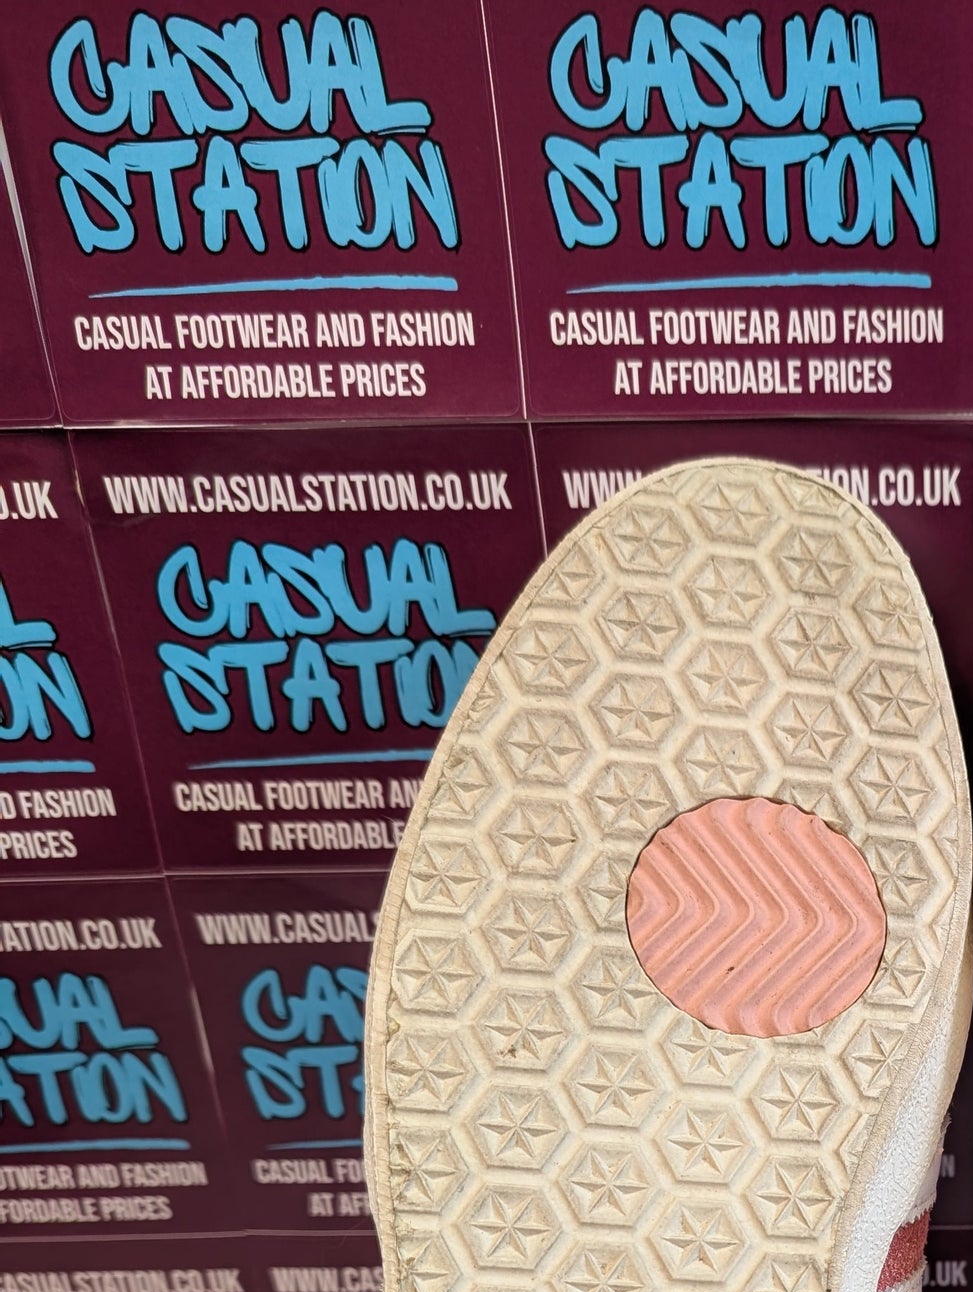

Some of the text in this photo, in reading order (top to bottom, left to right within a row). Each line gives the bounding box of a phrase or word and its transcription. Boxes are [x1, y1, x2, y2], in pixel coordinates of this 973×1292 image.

[50, 10, 432, 137] CASUAL
[549, 6, 924, 132] CASUAL
[53, 135, 460, 254] STATION
[542, 129, 939, 250] STATION
[75, 311, 475, 351] CASUAL FOOTWEAR AND FASHION
[550, 308, 943, 346] CASUAL FOOTWEAR AND FASHION
[146, 362, 426, 400] AT AFFORDABLE PRICES
[615, 359, 892, 395] AT AFFORDABLE PRICES
[104, 471, 512, 514] WWW.CASUALSTATION.CO.UK
[156, 539, 498, 639] CASUAL
[15, 788, 117, 819] FASHION
[173, 778, 424, 811] CASUAL FOOTWEAR AN
[237, 822, 266, 851] AT
[77, 1163, 120, 1188] AND
[120, 1161, 208, 1186] FASHION
[252, 1158, 334, 1183] CASUAL
[101, 1195, 173, 1221] PRICES
[309, 1192, 334, 1216] AT
